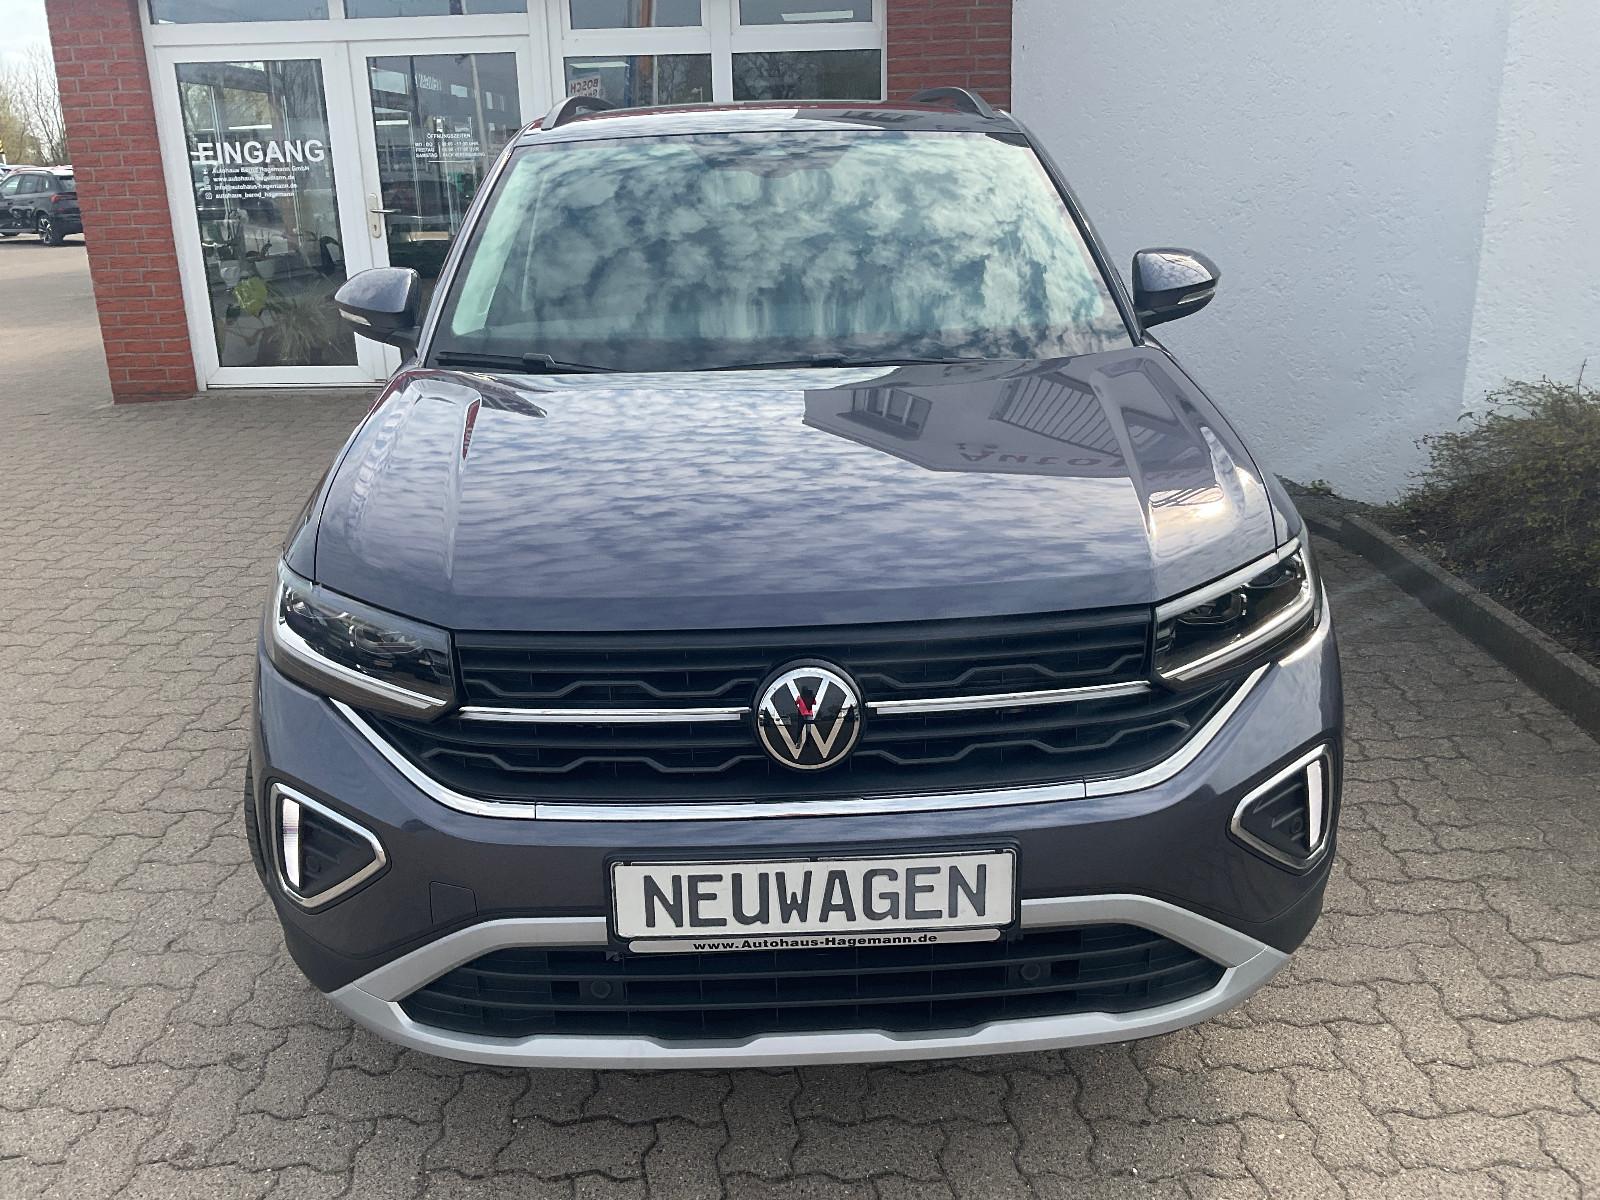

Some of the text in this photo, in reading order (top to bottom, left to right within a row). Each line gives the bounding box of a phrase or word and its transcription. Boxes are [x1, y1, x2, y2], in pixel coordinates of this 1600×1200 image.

[197, 139, 325, 165] EINGANG
[643, 863, 988, 929] NEUWAGEN
[692, 932, 938, 951] www.Autohaus-Hagemann.de
